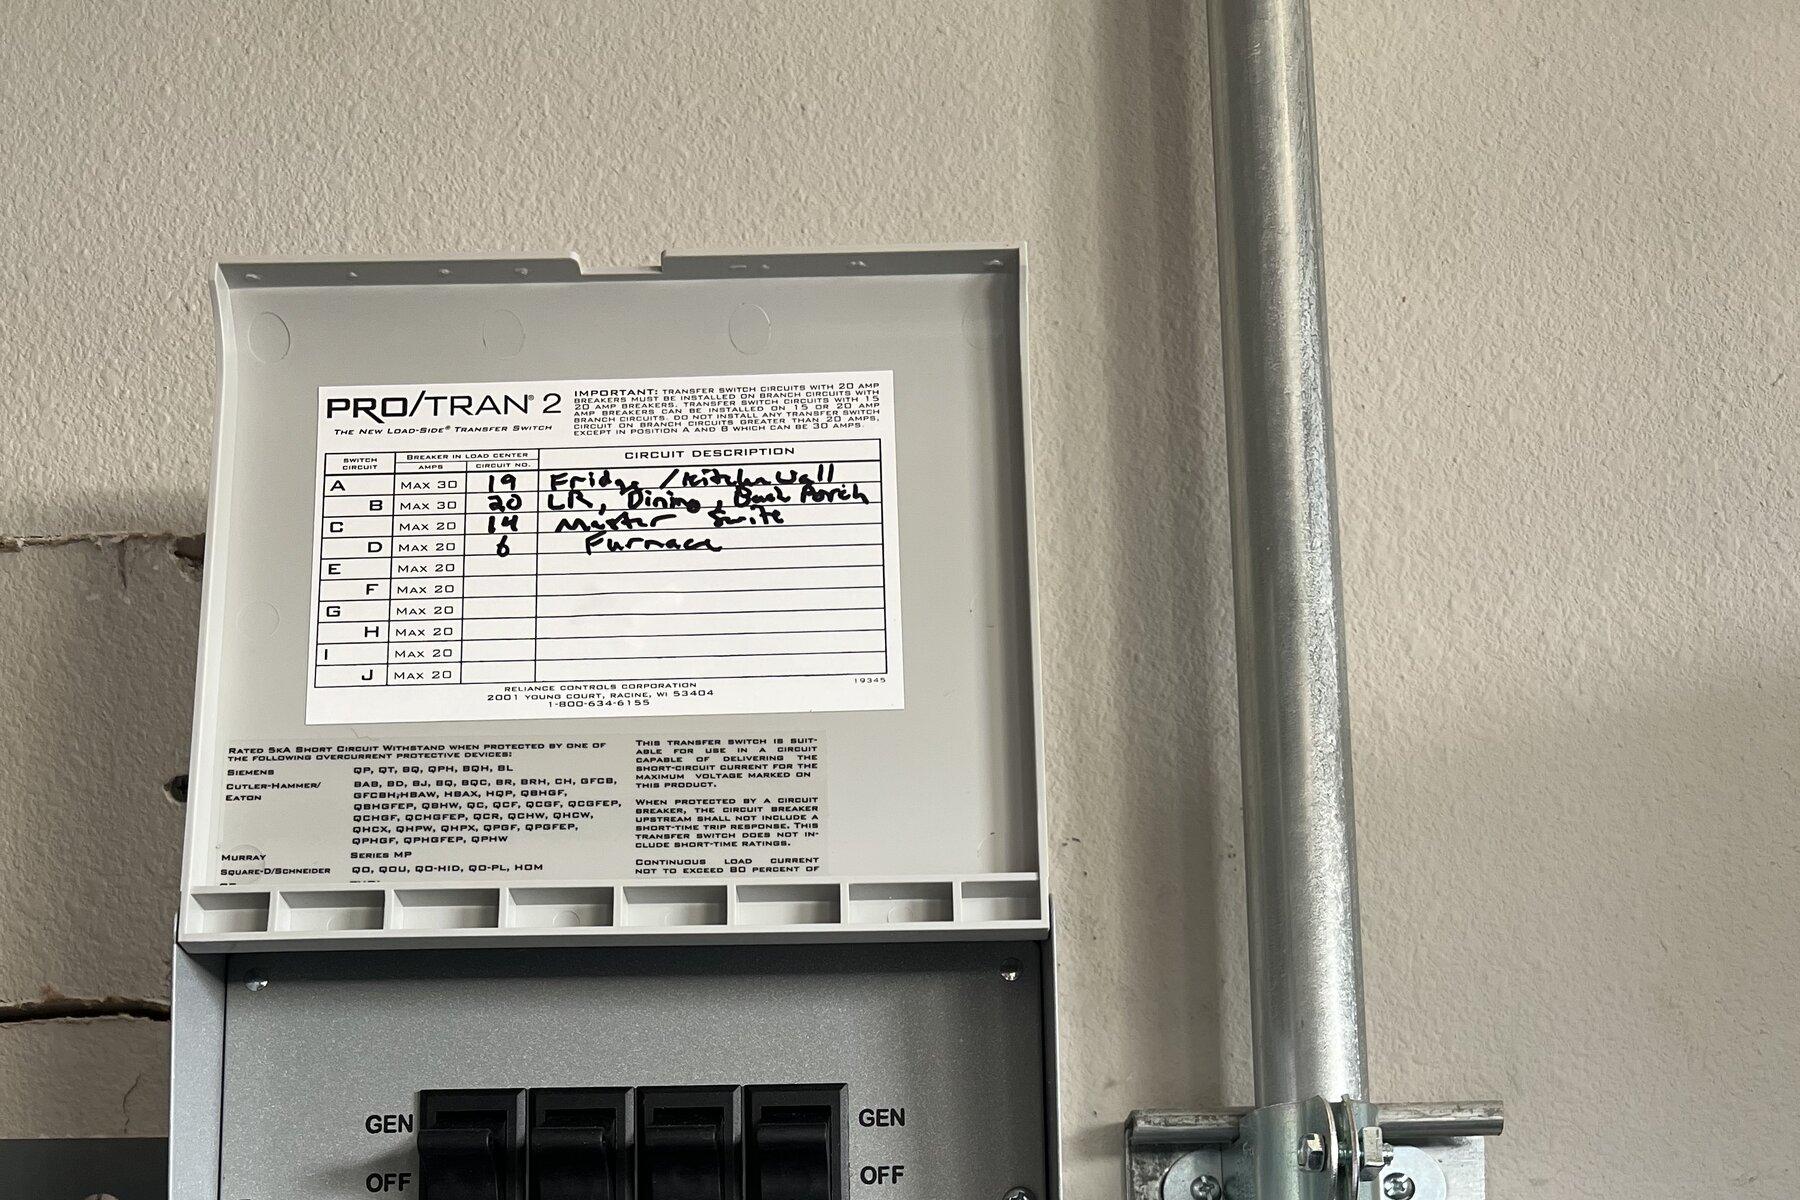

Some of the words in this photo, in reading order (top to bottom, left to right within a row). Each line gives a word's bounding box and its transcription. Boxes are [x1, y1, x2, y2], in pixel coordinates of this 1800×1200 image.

[542, 393, 561, 413] 2
[625, 451, 684, 460] CIRCUIT
[692, 447, 794, 458] DESCRIPTION
[330, 480, 345, 492] A
[401, 482, 430, 490] MAX
[437, 480, 457, 489] 30
[369, 500, 382, 511] B
[400, 502, 429, 511] MAX
[437, 501, 456, 510] 30
[487, 494, 522, 513] 20
[330, 522, 343, 533] C
[400, 523, 428, 531] MAX
[436, 522, 456, 531] 20
[368, 542, 382, 553] D
[398, 544, 427, 552] MAX
[436, 543, 455, 552] 20
[496, 535, 510, 557] 6
[328, 563, 340, 575] E
[398, 565, 427, 573] MAX
[435, 563, 454, 573] 20
[366, 584, 378, 595] F
[397, 586, 426, 594] MAX
[434, 585, 454, 594] 20
[326, 606, 340, 618] G
[396, 607, 425, 616] MAX
[434, 606, 453, 615] 20
[364, 626, 379, 638] H
[396, 629, 425, 637] MAX
[433, 627, 452, 636] 20
[395, 650, 424, 658] MAX
[432, 649, 452, 658] 20
[362, 669, 373, 681] J
[394, 672, 423, 680] MAX
[432, 670, 451, 680] 20
[622, 682, 696, 690] CORPORATION
[549, 699, 649, 708] 1-800-634-6155
[336, 745, 378, 753] CIRCUIT
[222, 854, 266, 862] MURRAY
[394, 851, 412, 859] MP
[220, 868, 330, 877] SQUARE-D/SCHNEIDER
[858, 1107, 905, 1127] GEN
[365, 1114, 413, 1134] GEN
[860, 1165, 904, 1184] OFF
[366, 1170, 412, 1194] OFF
